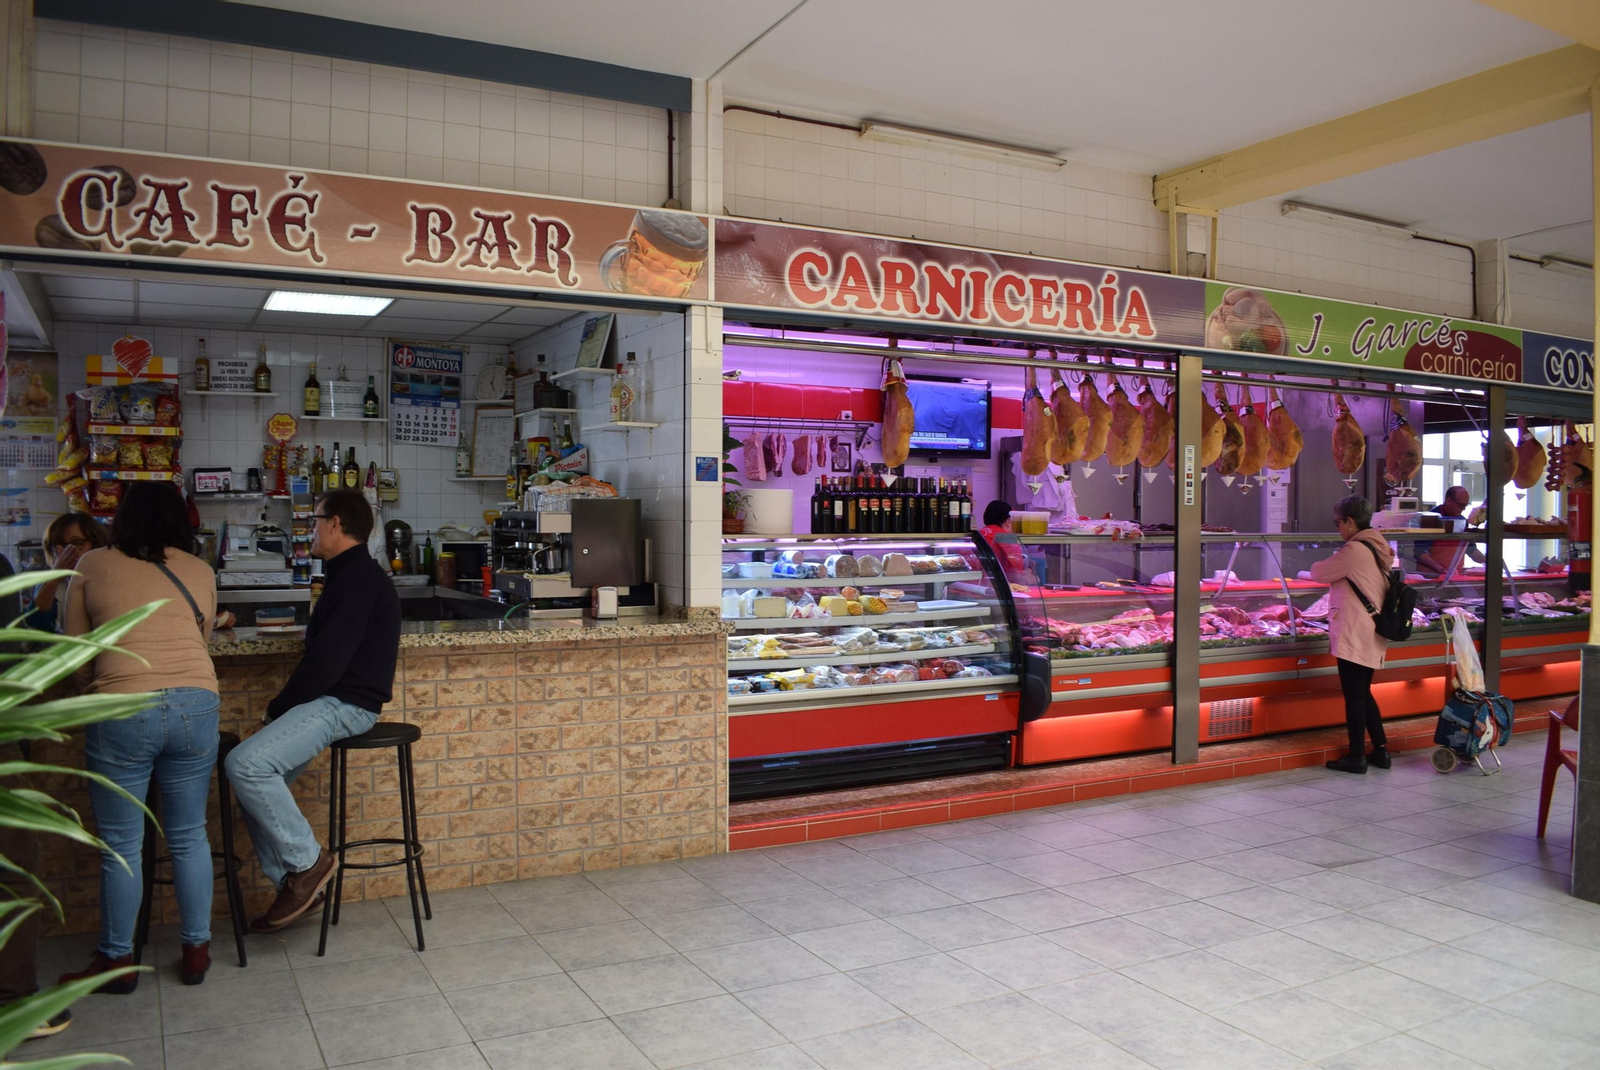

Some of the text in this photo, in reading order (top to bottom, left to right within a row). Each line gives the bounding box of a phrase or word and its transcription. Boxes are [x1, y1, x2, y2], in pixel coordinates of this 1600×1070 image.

[60, 174, 324, 263] CAFÉ
[405, 204, 579, 287] BAR
[787, 250, 1156, 338] CARNICERÍA
[1296, 313, 1468, 360] J. Garcés
[416, 357, 460, 371] MONTOYA
[1420, 352, 1516, 381] carnicería
[554, 460, 582, 472] Pictolin
